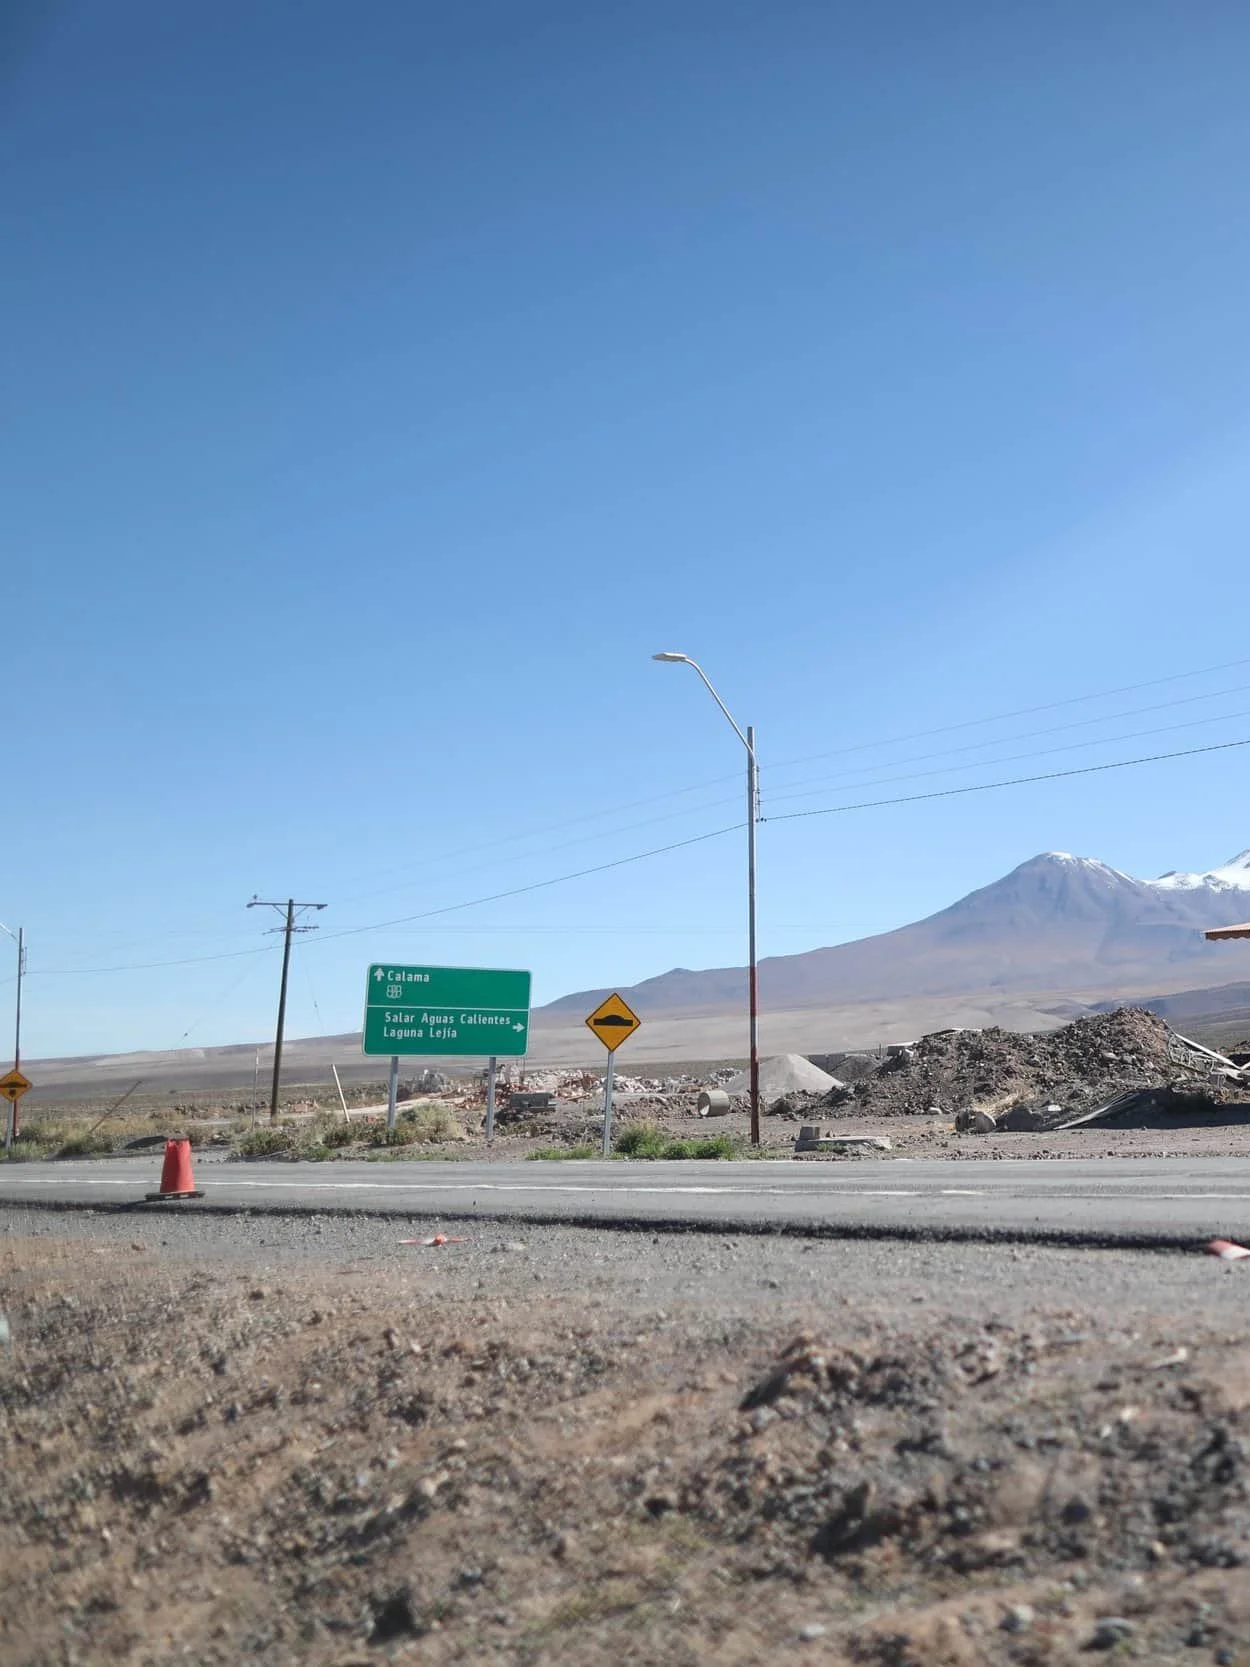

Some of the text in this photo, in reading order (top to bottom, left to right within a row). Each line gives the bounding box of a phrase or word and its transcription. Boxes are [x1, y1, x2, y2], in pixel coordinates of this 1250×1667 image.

[387, 970, 430, 983] Calama
[384, 1011, 511, 1026] Salar Aguas Calientes
[383, 1026, 458, 1040] Laguna Lejía
